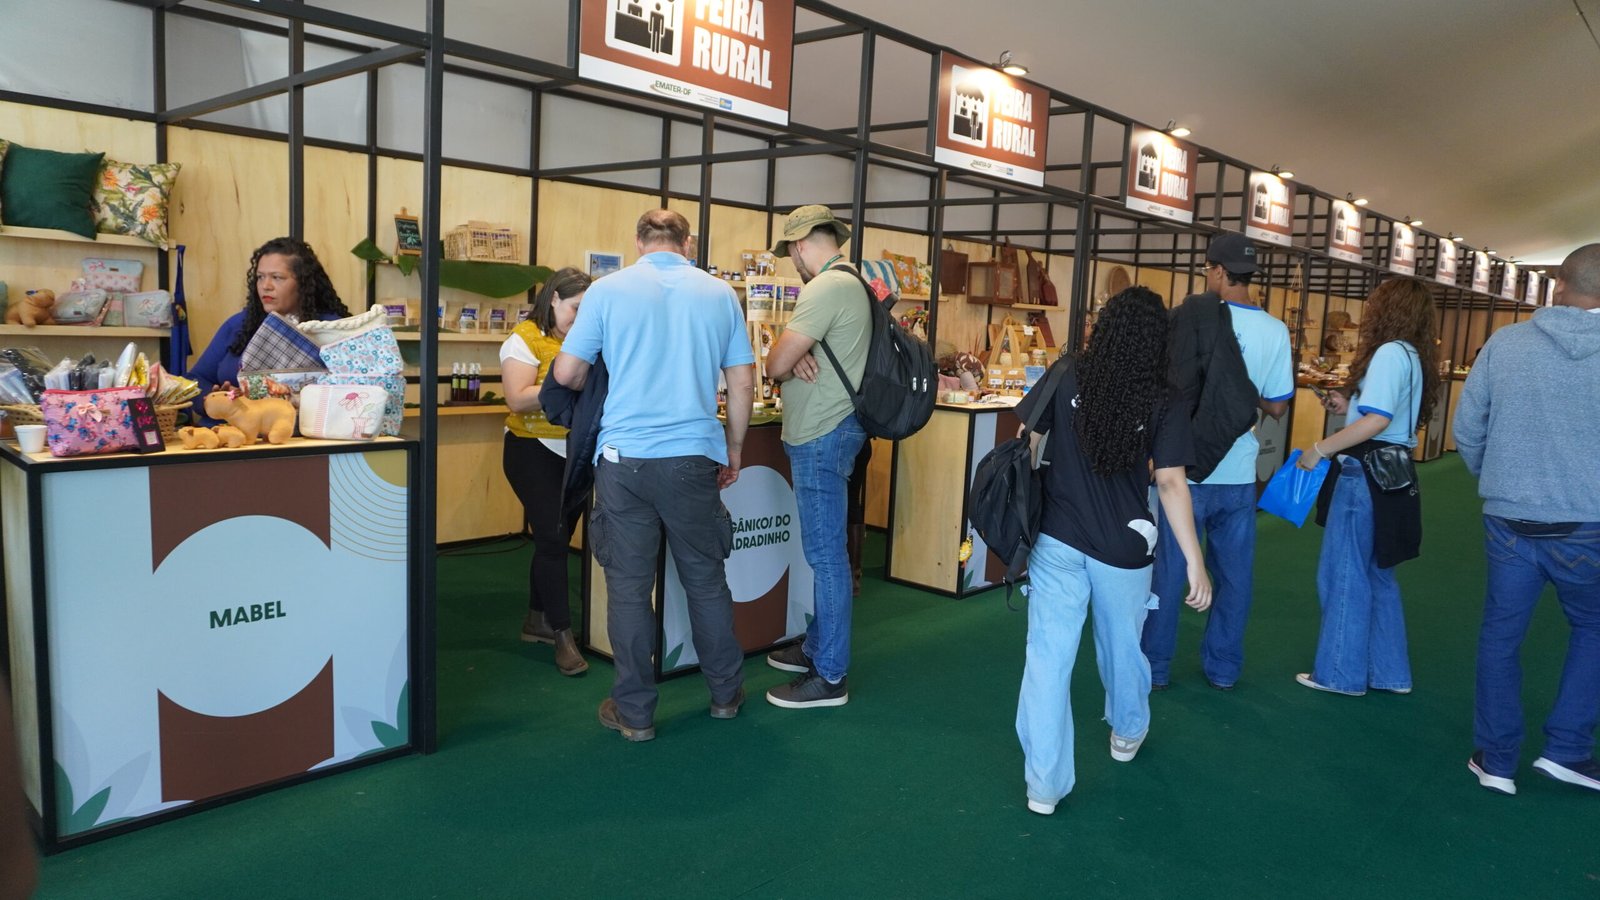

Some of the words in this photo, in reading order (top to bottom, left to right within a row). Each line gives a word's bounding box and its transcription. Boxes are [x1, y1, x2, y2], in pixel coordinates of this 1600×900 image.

[692, 25, 773, 90] RURAL
[992, 117, 1036, 157] RURAL
[731, 516, 773, 534] GÂNICOS
[775, 513, 791, 528] DO
[209, 600, 287, 629] MABEL
